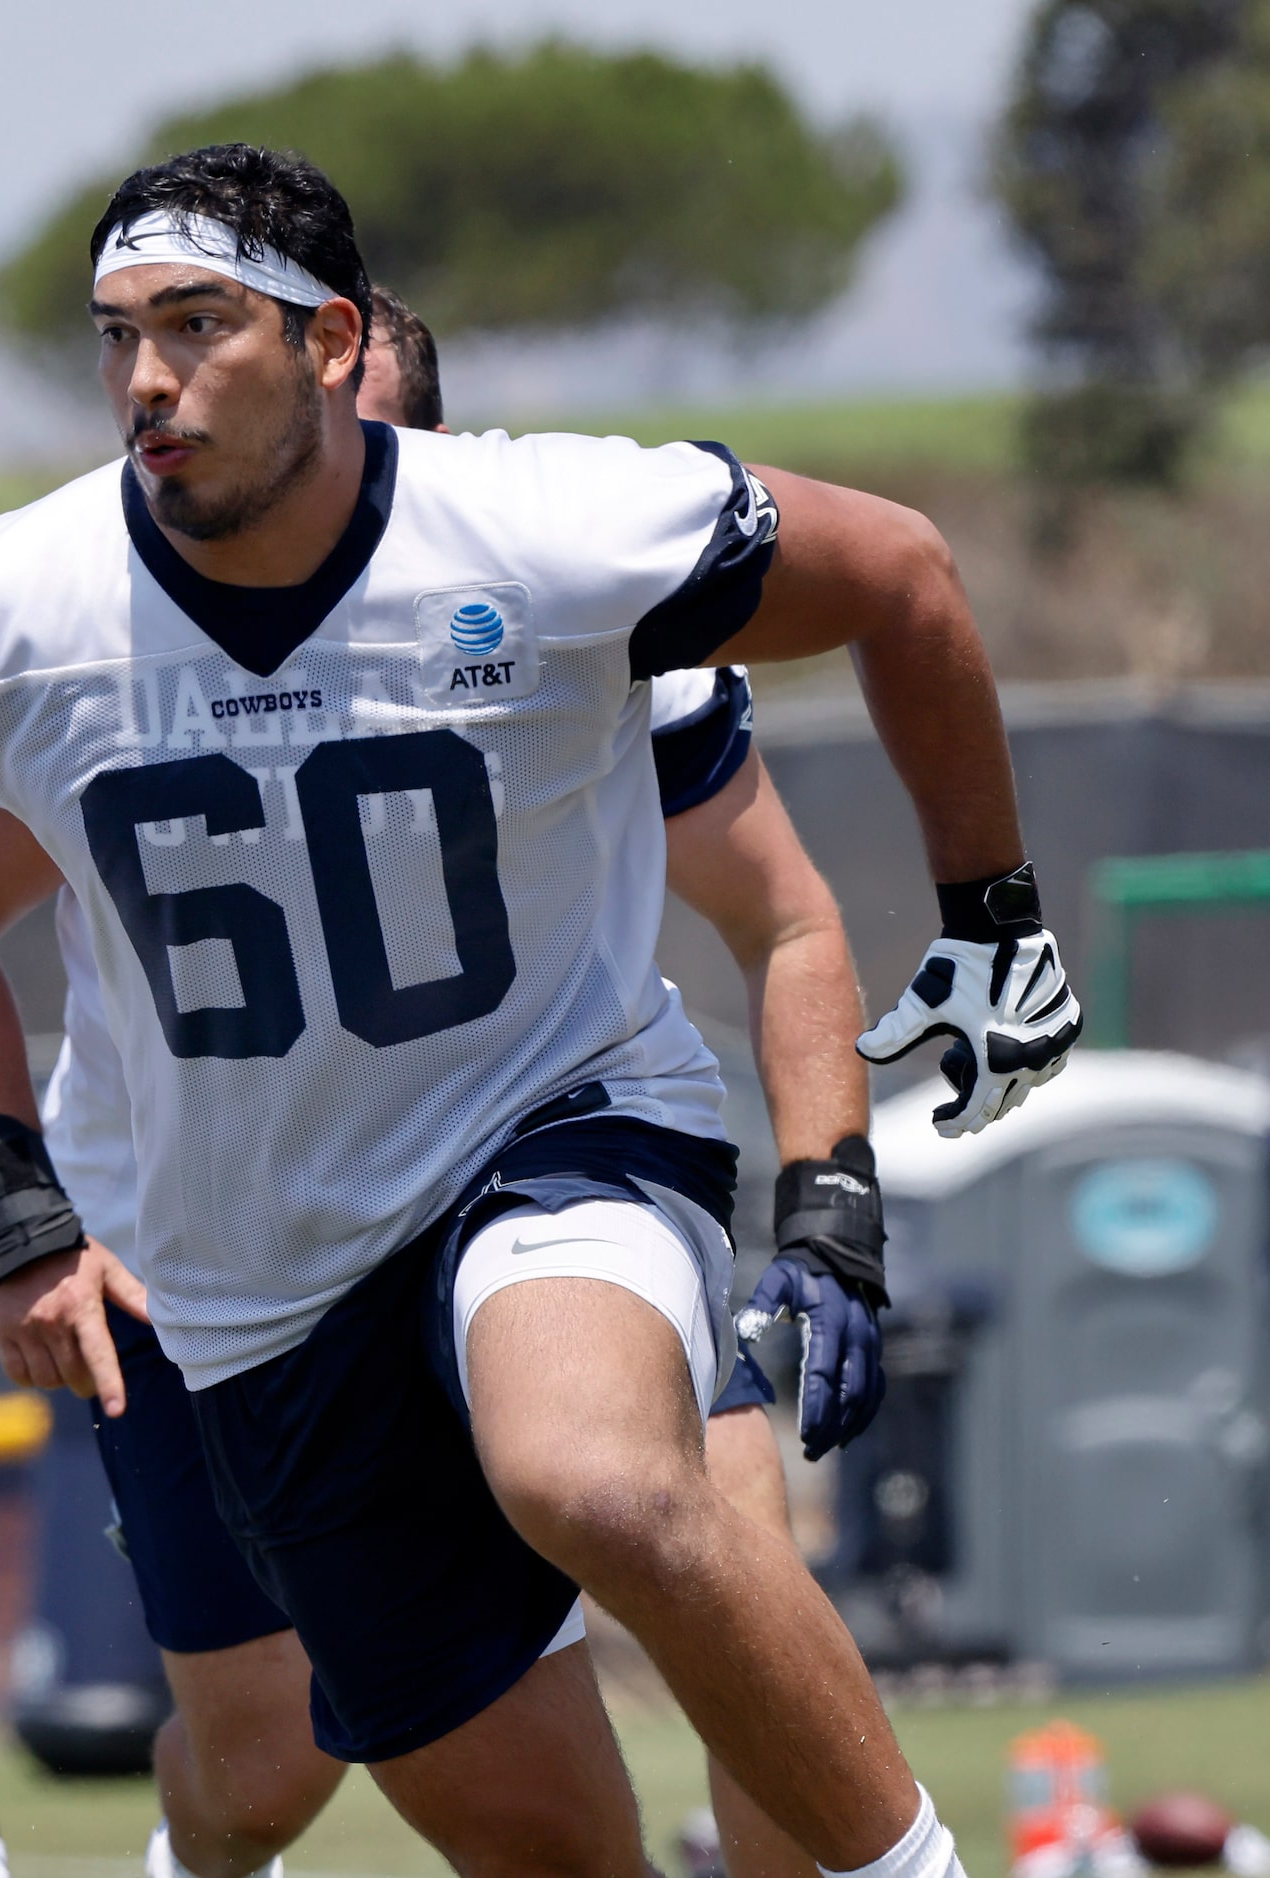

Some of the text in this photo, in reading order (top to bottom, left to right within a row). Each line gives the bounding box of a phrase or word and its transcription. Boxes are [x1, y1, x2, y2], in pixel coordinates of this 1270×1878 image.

[450, 661, 515, 690] AT&T
[211, 690, 322, 719] COWBOYS
[80, 728, 517, 1058] 60
